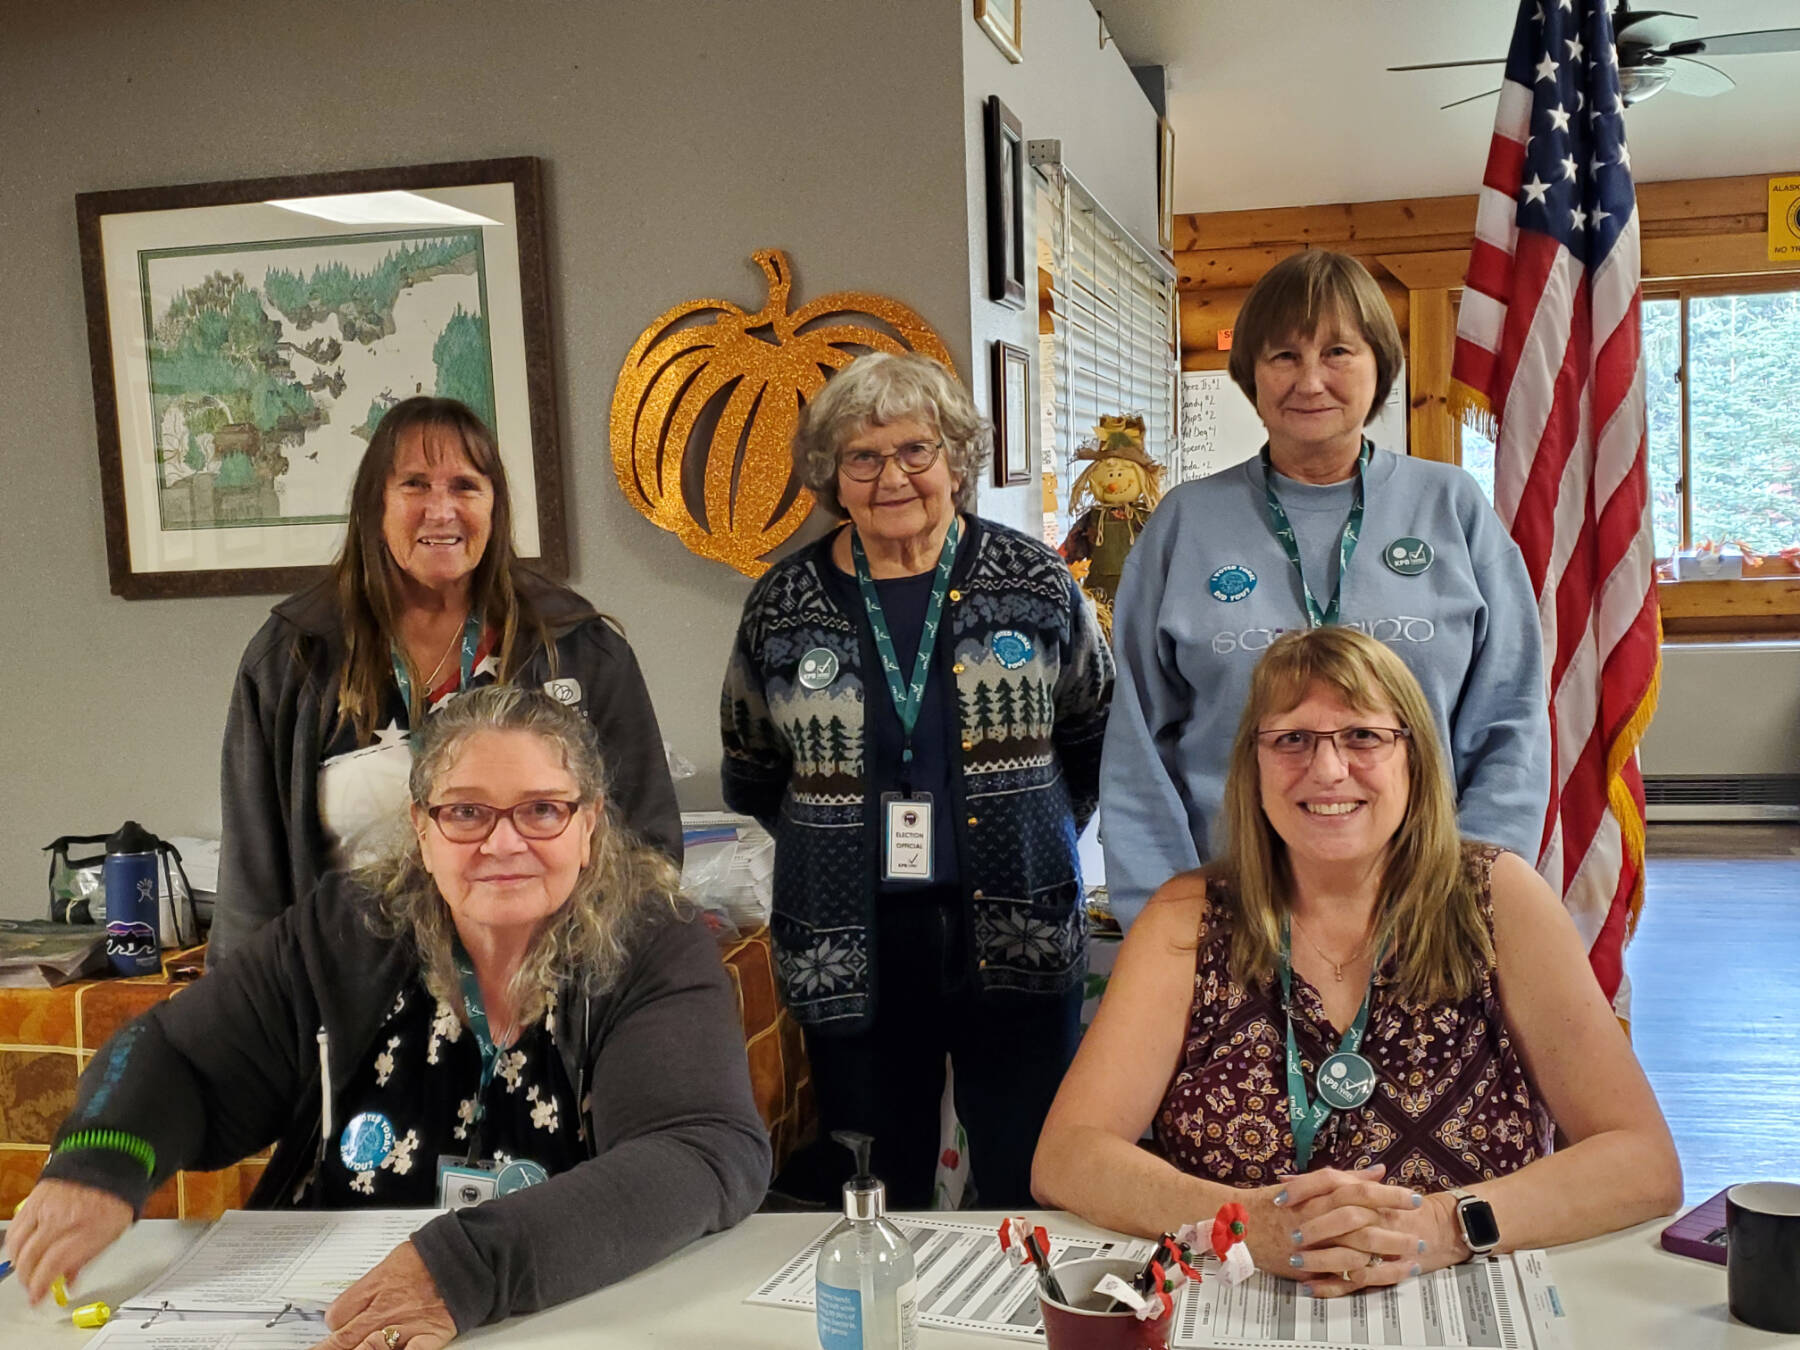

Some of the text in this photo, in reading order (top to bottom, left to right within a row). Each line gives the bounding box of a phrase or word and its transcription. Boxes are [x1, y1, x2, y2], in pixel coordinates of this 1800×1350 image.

[1182, 411, 1202, 425] hips
[1230, 587, 1250, 601] YOU?
[1321, 1074, 1339, 1090] KPB
